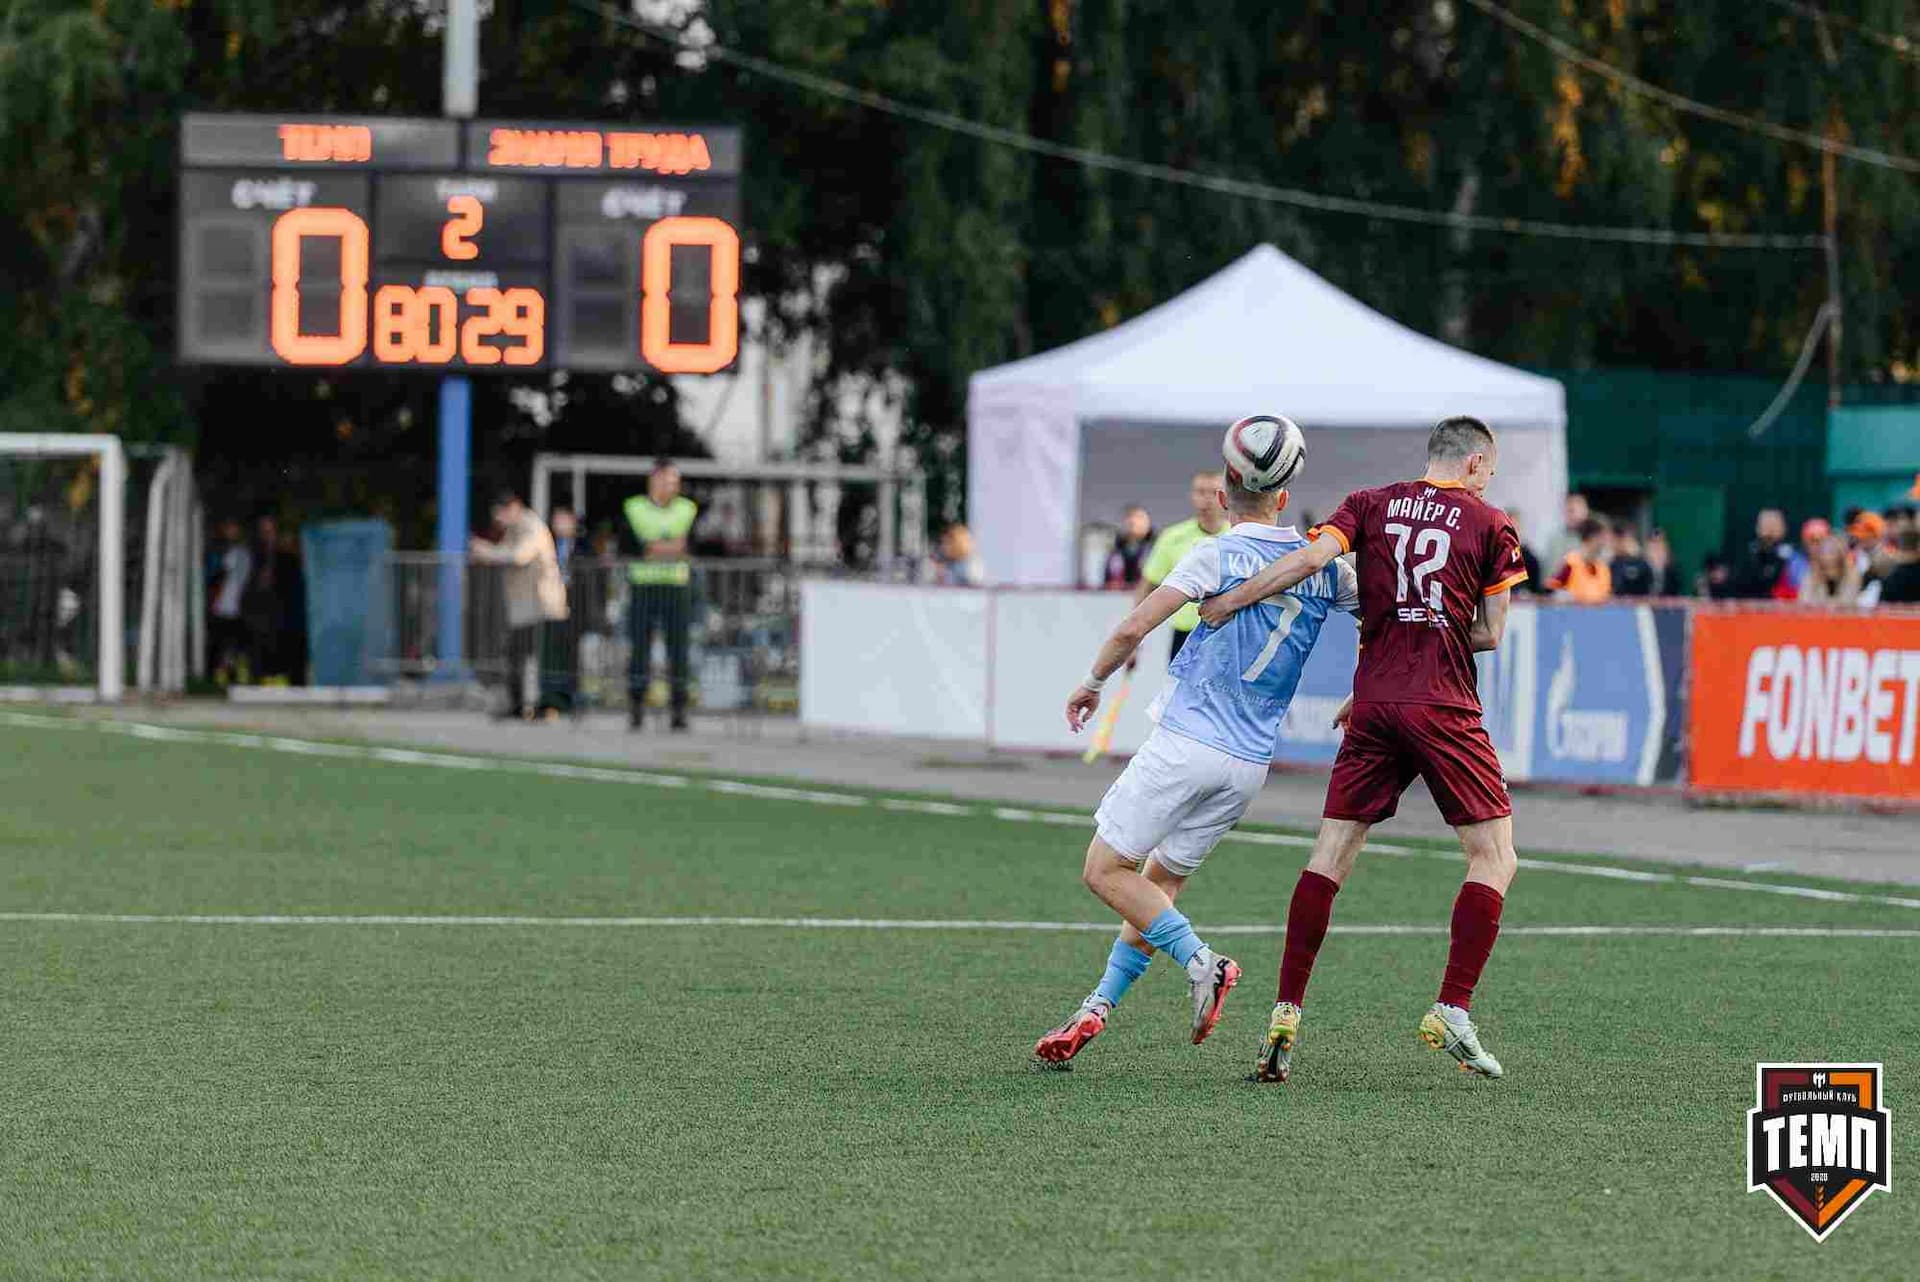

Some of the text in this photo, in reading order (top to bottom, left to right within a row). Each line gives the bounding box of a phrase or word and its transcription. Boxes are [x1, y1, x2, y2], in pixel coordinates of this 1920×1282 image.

[442, 195, 483, 260] 2
[271, 207, 369, 366] 0
[641, 216, 740, 374] 0
[1387, 495, 1446, 522] МАЙЕР
[1385, 523, 1451, 610] 72
[1240, 595, 1303, 682] 7
[1738, 645, 1920, 765] FONBET
